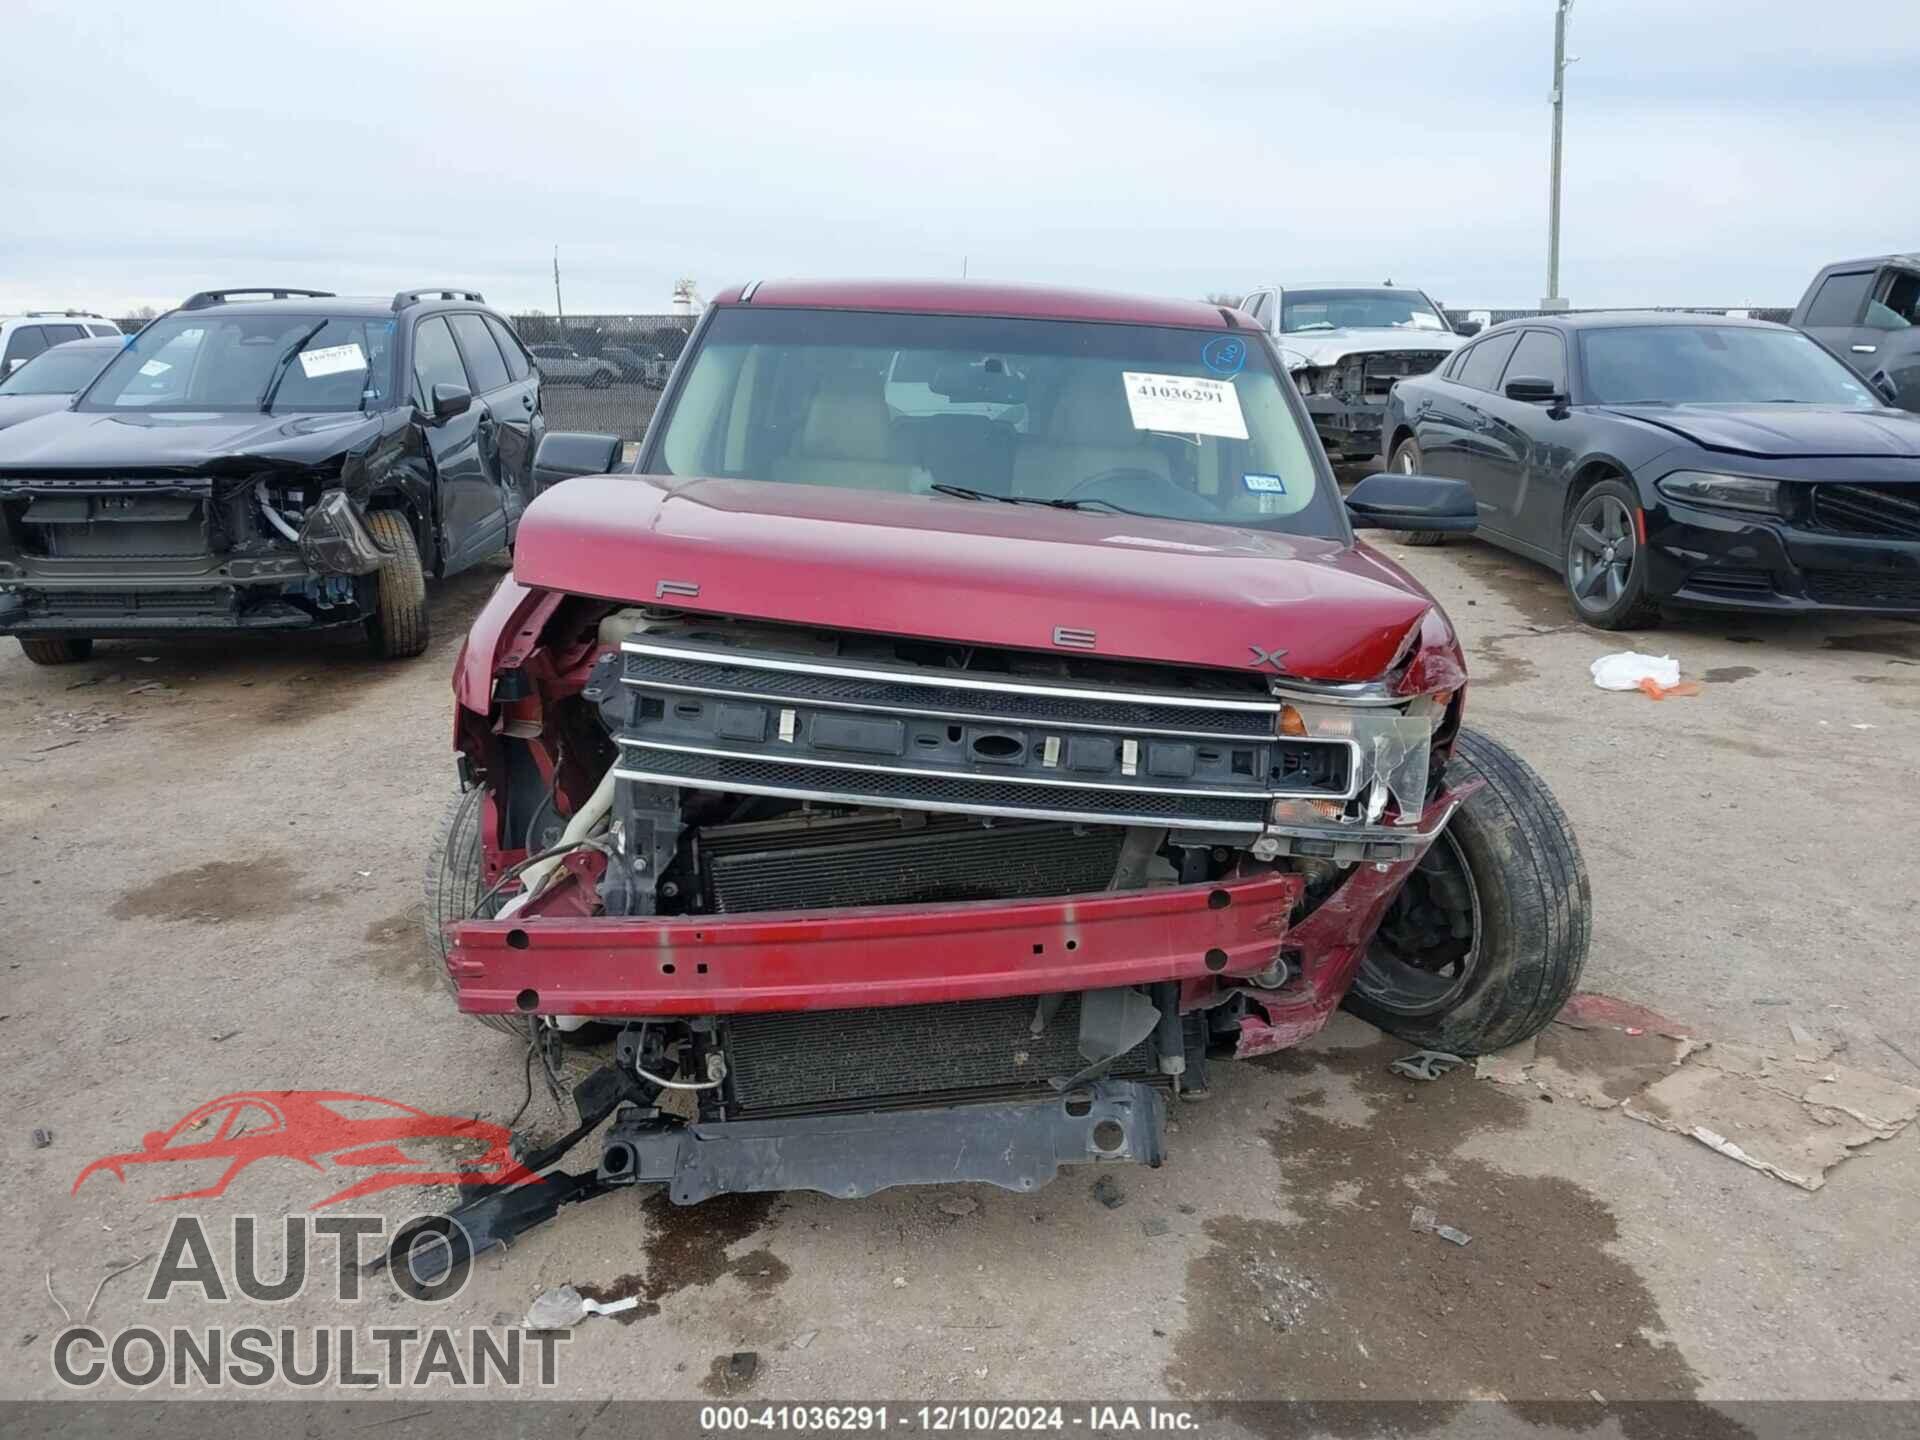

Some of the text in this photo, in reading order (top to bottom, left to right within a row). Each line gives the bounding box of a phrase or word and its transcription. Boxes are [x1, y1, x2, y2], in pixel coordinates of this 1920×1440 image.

[1138, 385, 1223, 403] 41036291
[656, 579, 1288, 670] F E X
